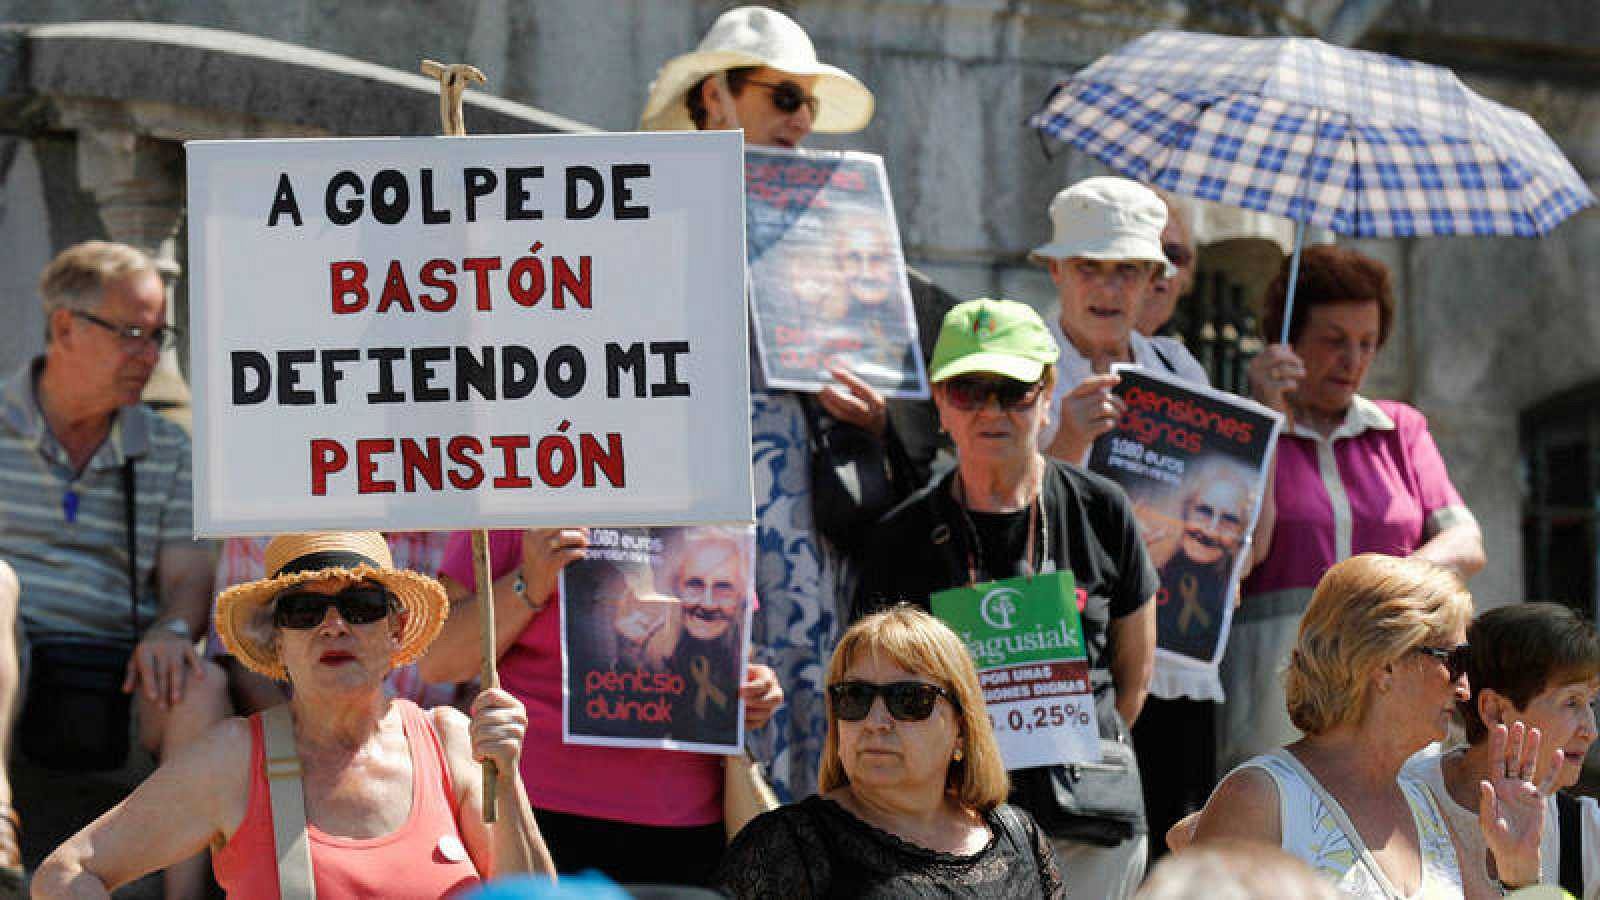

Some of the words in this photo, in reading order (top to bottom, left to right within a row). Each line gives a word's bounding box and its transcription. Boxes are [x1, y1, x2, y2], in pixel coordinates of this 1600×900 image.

[267, 172, 303, 227] A
[325, 165, 545, 226] GOLPE
[564, 163, 651, 221] DE
[329, 240, 593, 315] BASTÓN
[230, 343, 587, 406] DEFIENDO
[605, 340, 691, 399] MI
[1126, 386, 1255, 444] pensiones
[309, 418, 627, 497] PENSIÓN
[1008, 702, 1090, 733] 0,25%
